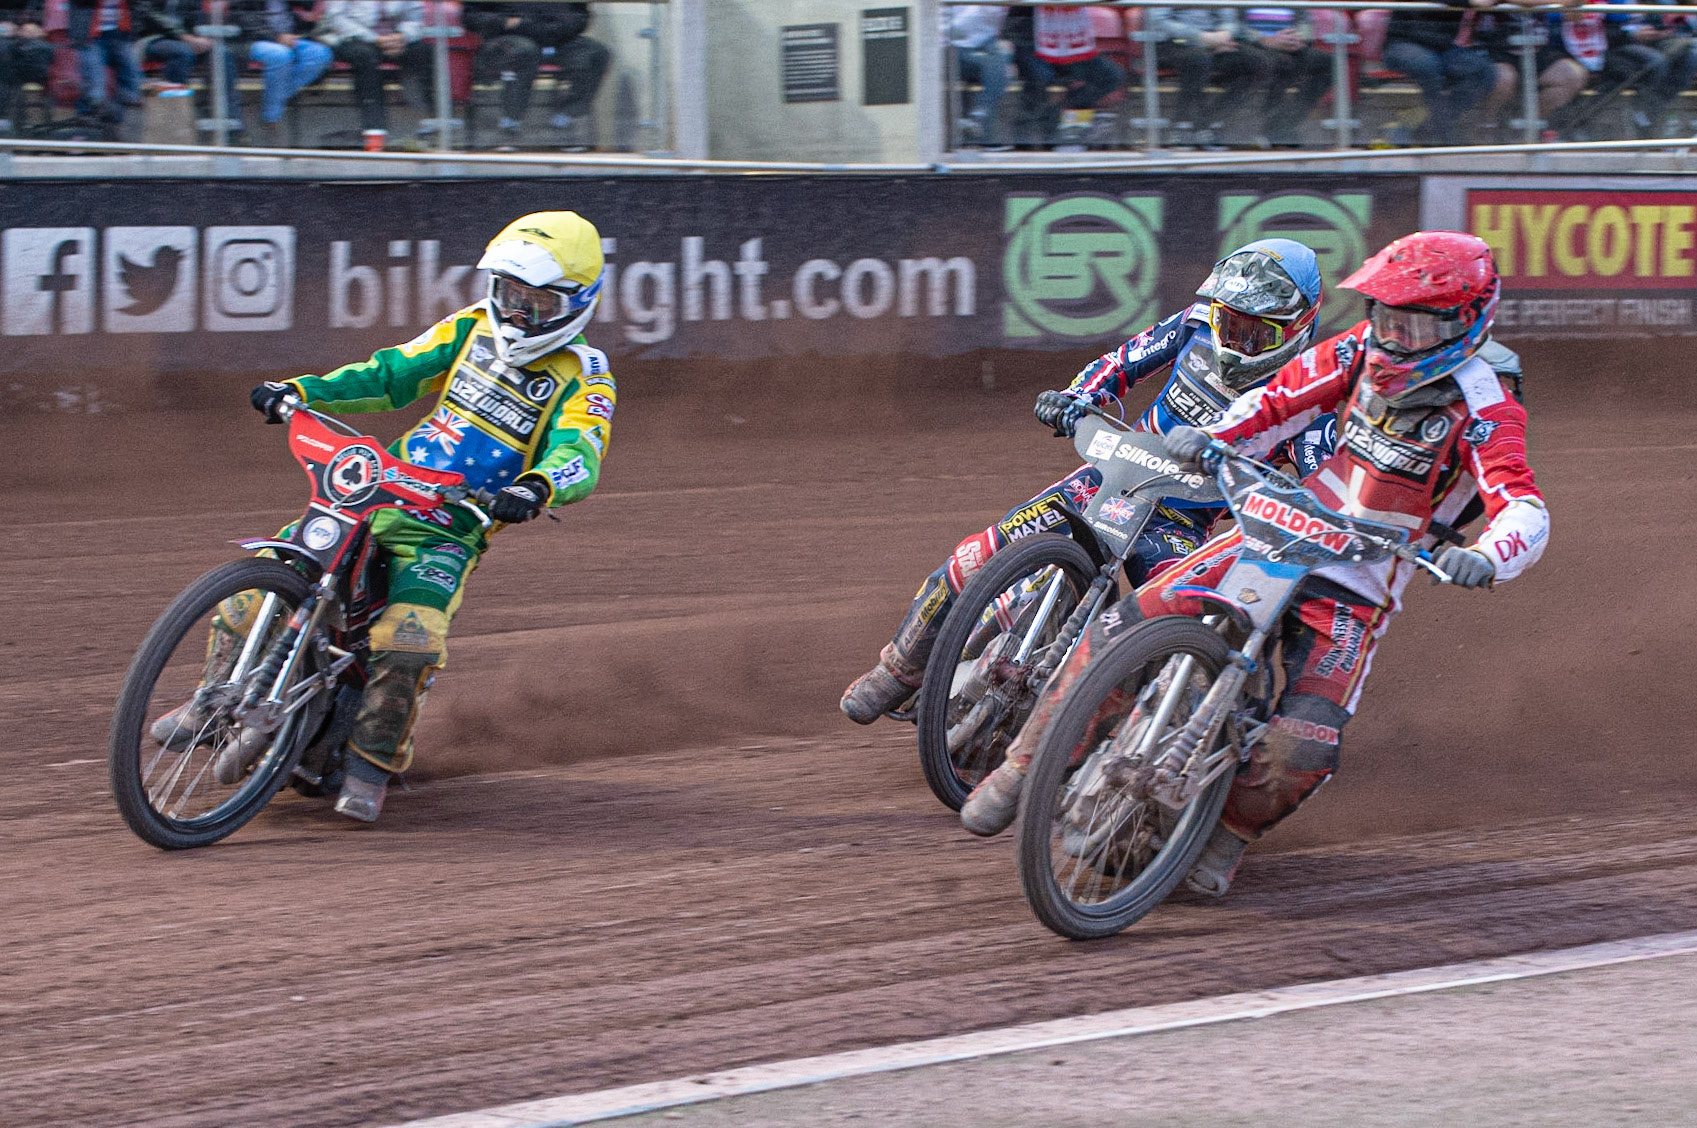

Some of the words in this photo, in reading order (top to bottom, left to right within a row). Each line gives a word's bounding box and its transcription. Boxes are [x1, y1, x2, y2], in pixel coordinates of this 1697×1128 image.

[1473, 204, 1694, 277] HYCOTE
[1245, 495, 1351, 553] MOLDOW
[1495, 530, 1528, 562] DK
